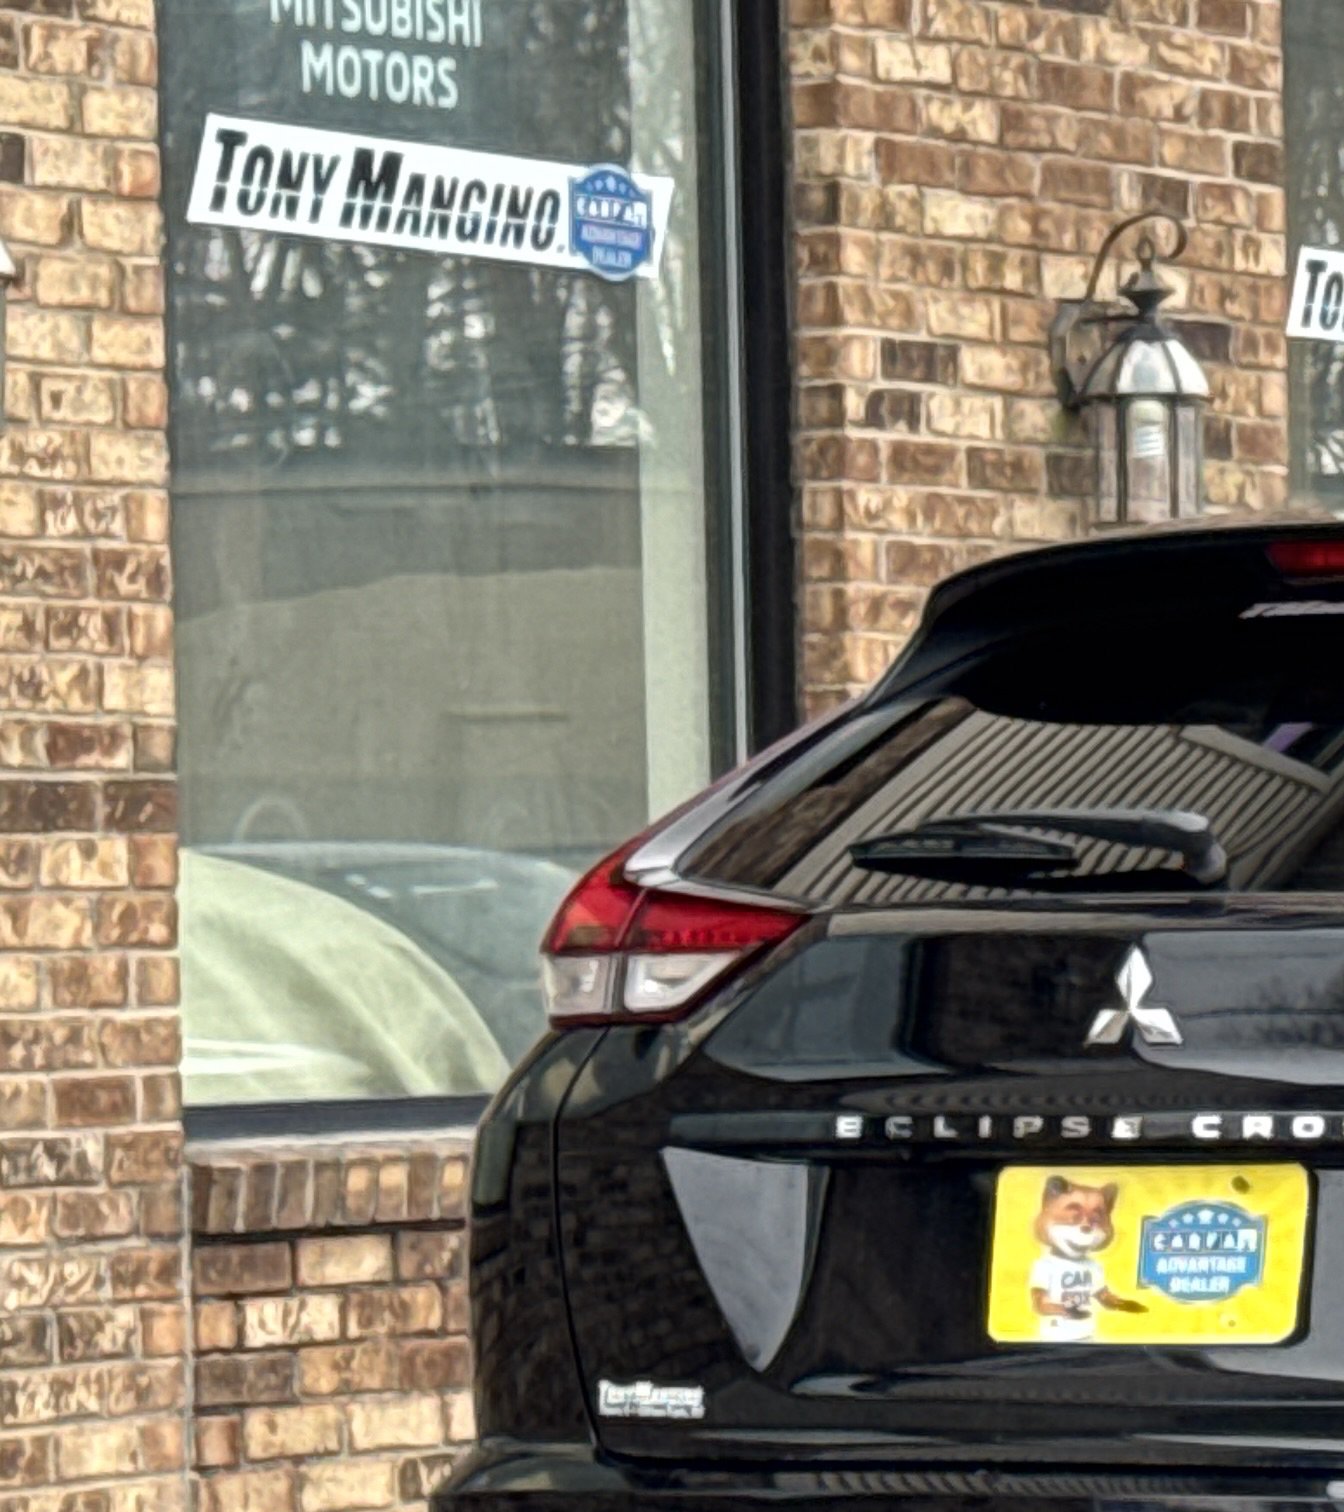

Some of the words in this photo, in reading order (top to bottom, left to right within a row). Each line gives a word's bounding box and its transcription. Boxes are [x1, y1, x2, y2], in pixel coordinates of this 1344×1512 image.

[301, 39, 459, 109] MOTORS
[209, 128, 341, 224] TONY
[835, 1114, 1144, 1140] ECLIPSE
